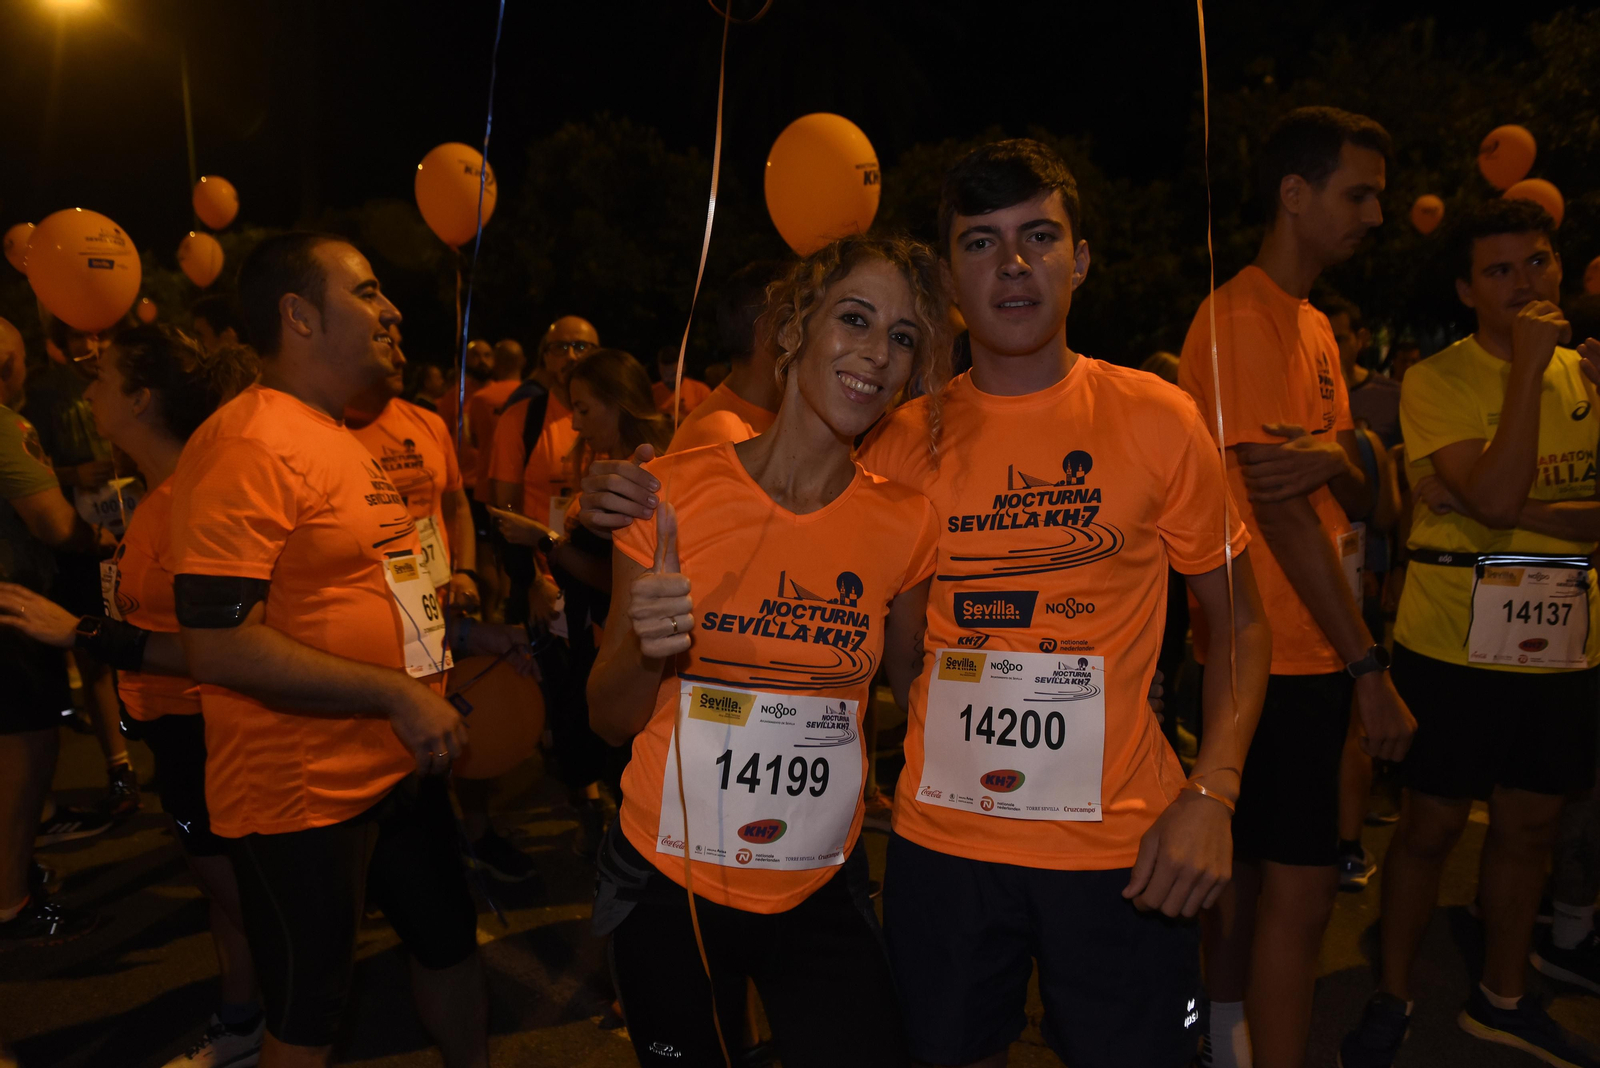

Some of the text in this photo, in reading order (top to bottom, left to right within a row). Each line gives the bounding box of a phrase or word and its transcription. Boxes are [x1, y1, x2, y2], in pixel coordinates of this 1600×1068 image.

[1538, 450, 1594, 465] ARATON
[992, 488, 1102, 510] NOCTURNA
[948, 511, 1040, 533] SEVILLA
[759, 599, 870, 630] NOCTURNA
[1502, 600, 1572, 626] 14137
[702, 612, 808, 643] SEVILLA
[1034, 676, 1070, 684] SEVILLA
[1052, 670, 1092, 678] NOCTURNA
[806, 721, 835, 730] SEVILLA
[822, 714, 850, 722] NOCTURNA
[960, 704, 1066, 750] 14200
[715, 749, 830, 798] 14199
[1064, 806, 1096, 814] Cruzcampo
